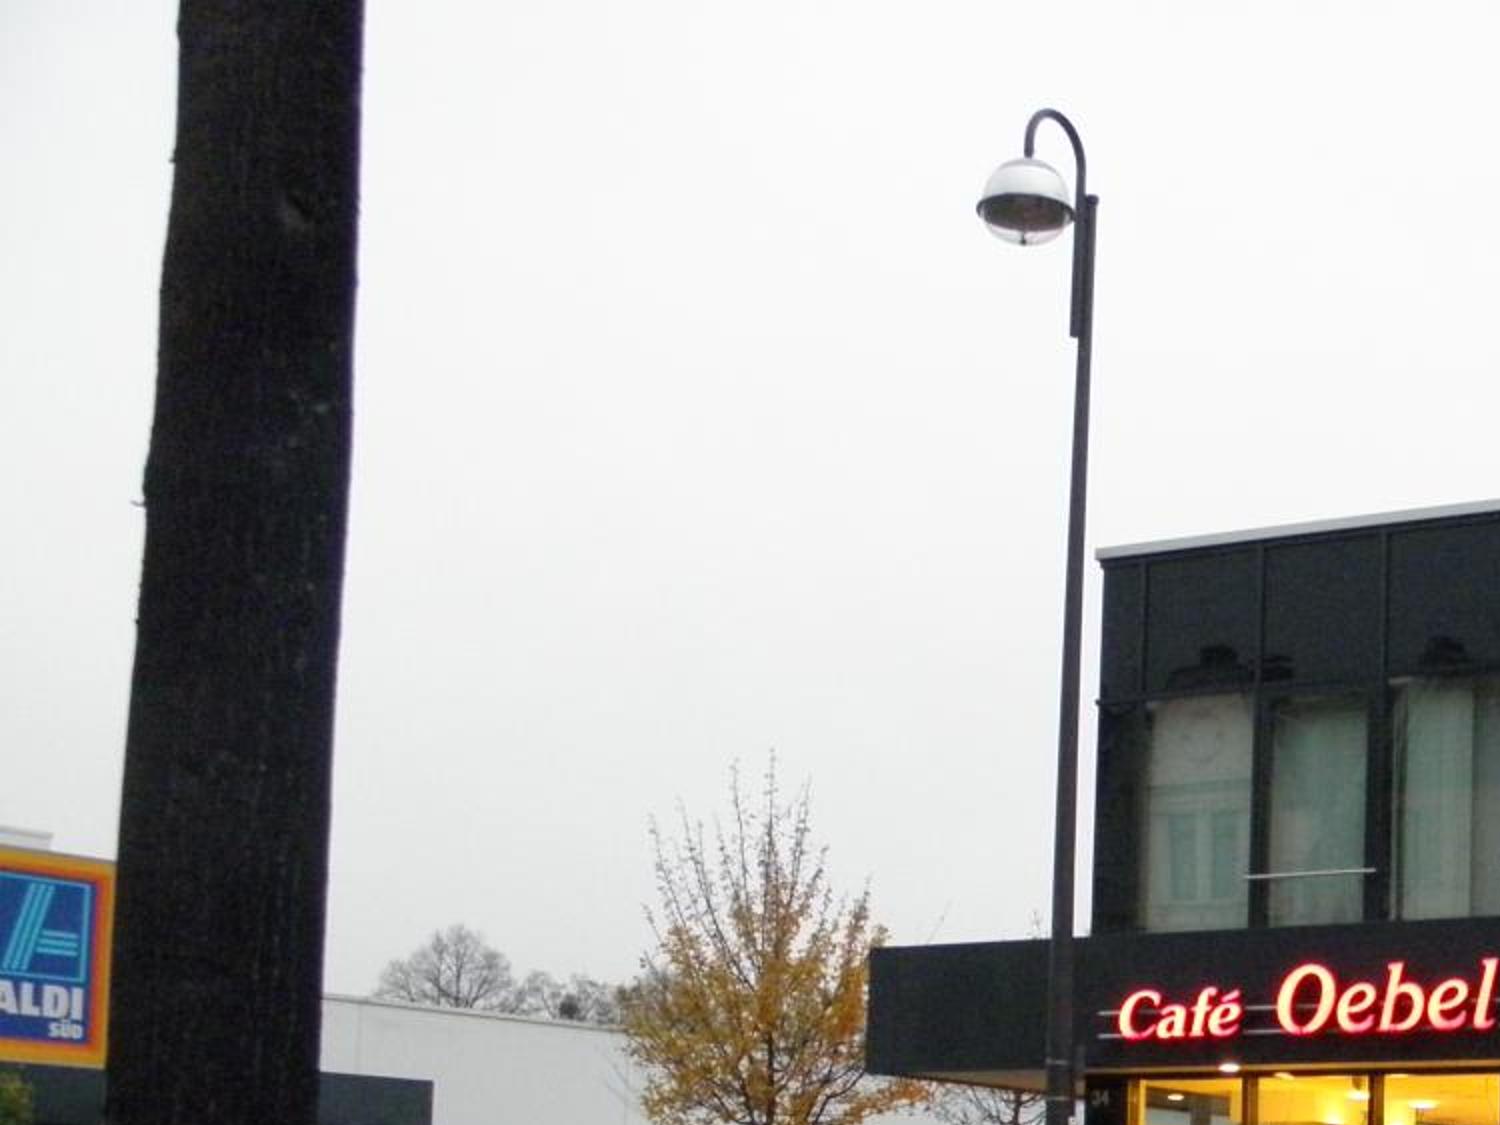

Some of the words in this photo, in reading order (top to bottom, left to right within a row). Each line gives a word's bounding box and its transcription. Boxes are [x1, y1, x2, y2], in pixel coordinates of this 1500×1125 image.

[0, 980, 84, 1021] ALDI
[1118, 985, 1242, 1040] Café
[1276, 957, 1500, 1036] Oebel
